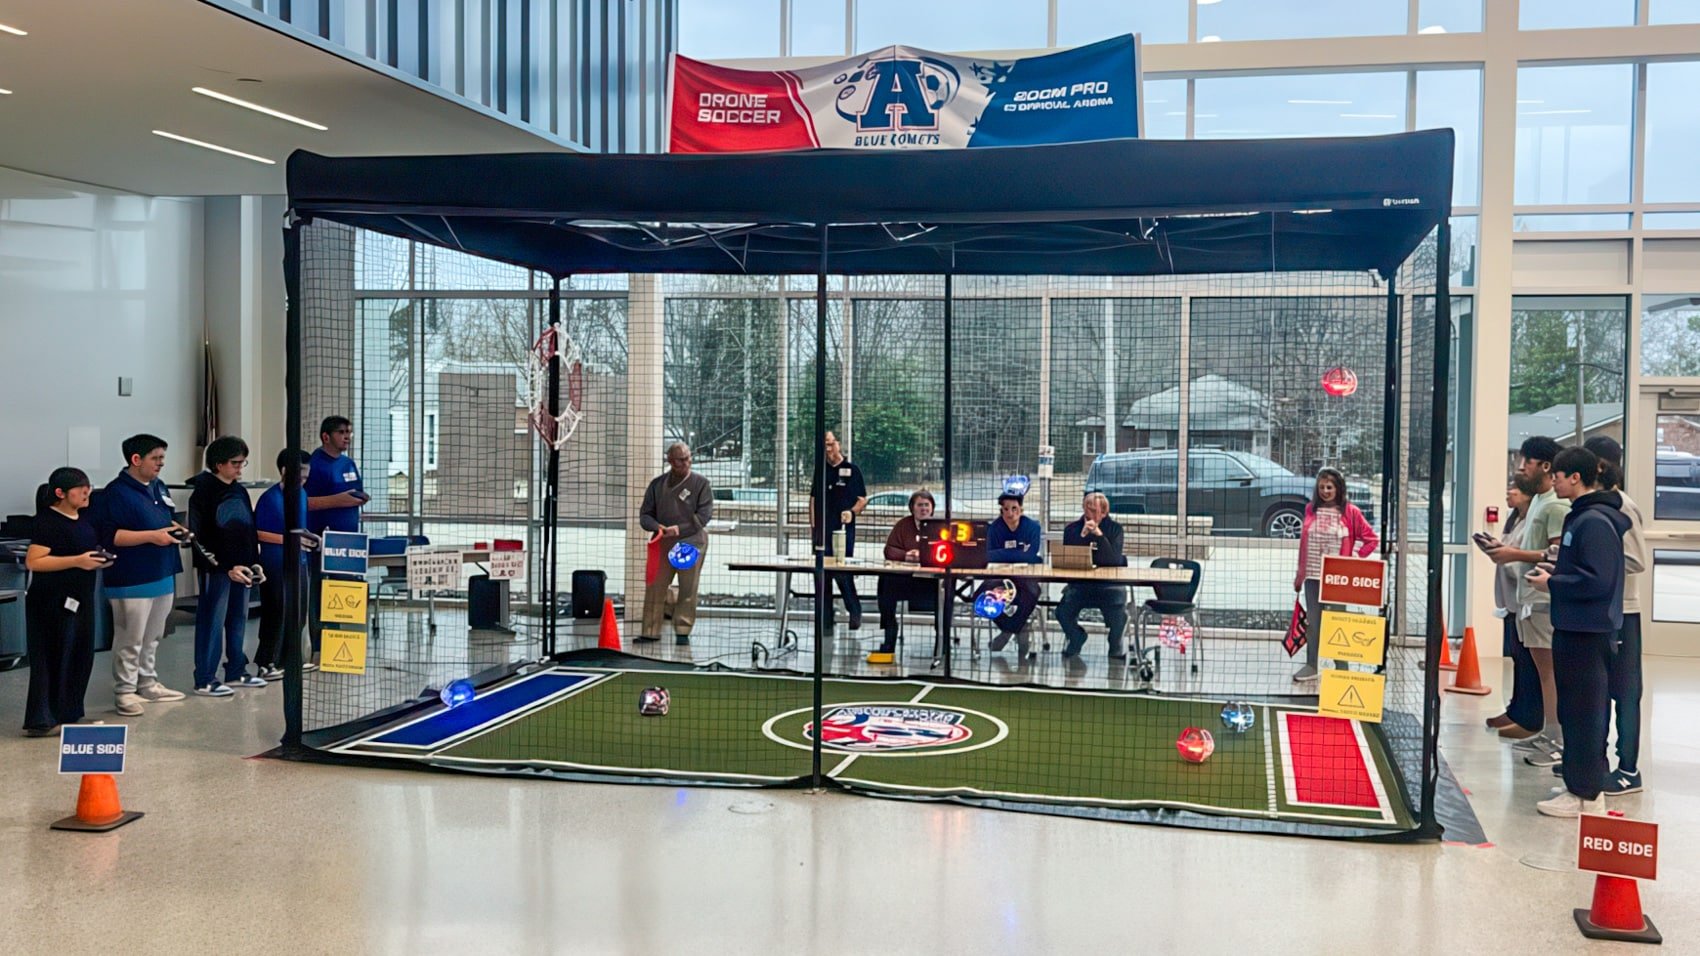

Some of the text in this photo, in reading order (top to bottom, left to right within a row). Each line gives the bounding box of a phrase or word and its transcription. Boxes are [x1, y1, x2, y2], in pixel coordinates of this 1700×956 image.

[1070, 81, 1109, 96] PRO
[699, 93, 768, 108] DRONE
[697, 108, 781, 123] SOCCER
[854, 134, 888, 146] BLUE
[1325, 574, 1381, 589] RED SIDE
[62, 743, 124, 755] BLUE SIDE
[1583, 836, 1653, 857] RED SIDE
